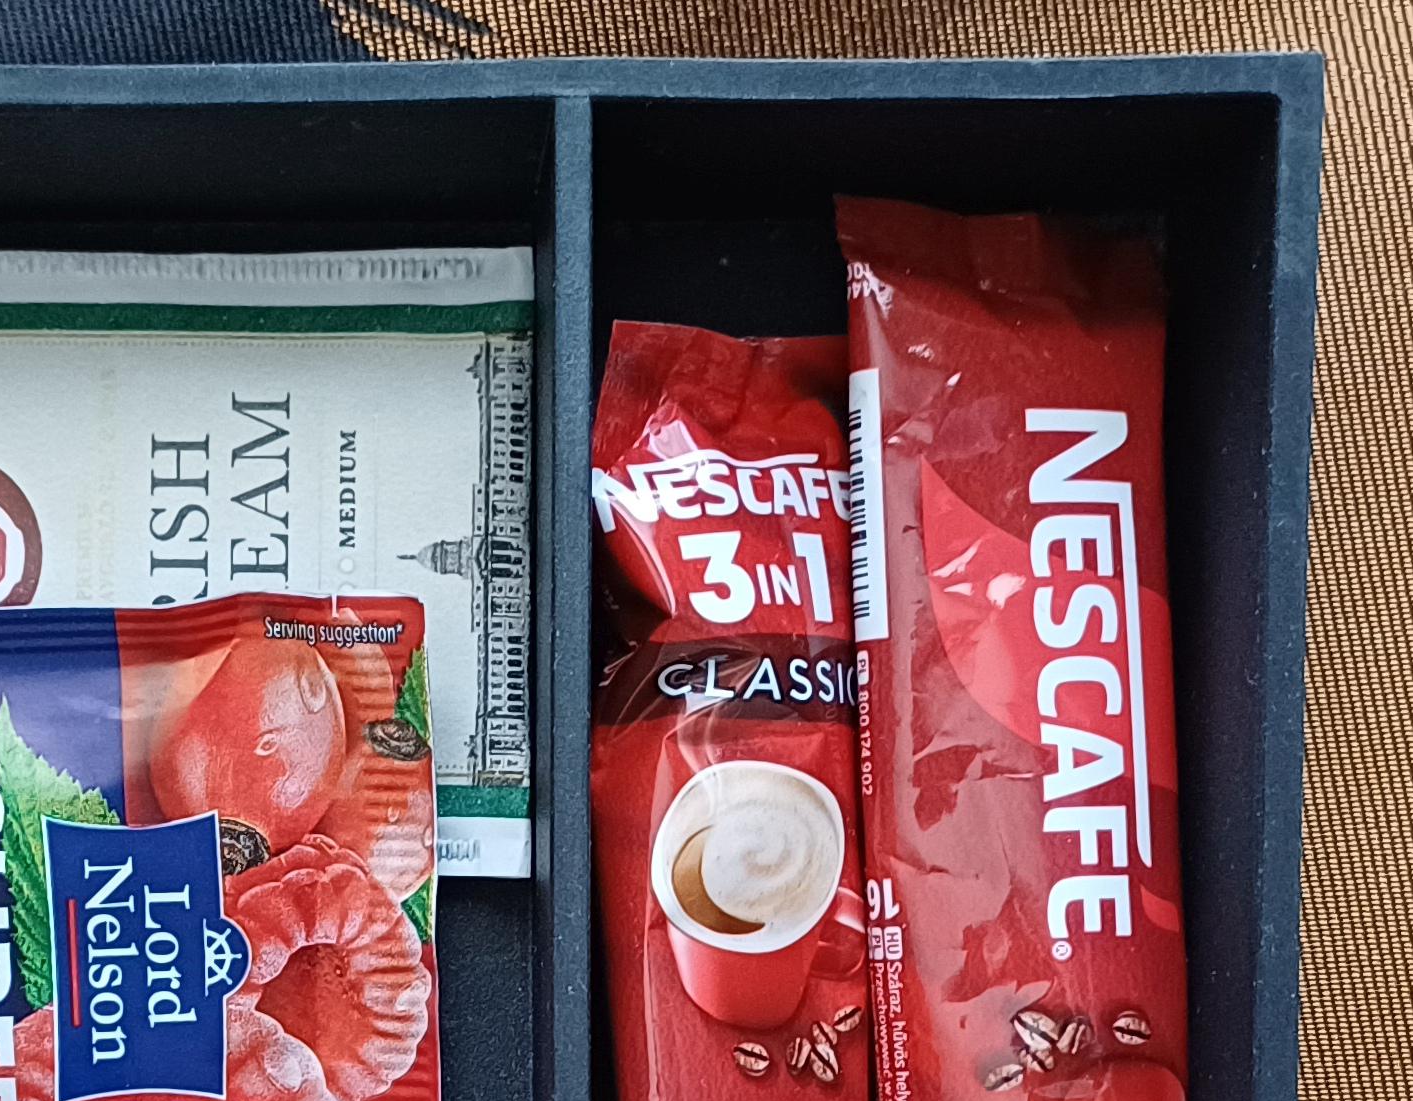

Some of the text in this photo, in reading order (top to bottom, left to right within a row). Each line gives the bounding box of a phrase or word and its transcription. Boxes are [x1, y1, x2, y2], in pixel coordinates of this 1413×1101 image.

[338, 429, 357, 549] MEDIUM
[264, 615, 316, 650] Serving
[858, 689, 870, 727] 800
[859, 729, 872, 759] 174
[860, 760, 874, 797] 902
[83, 855, 140, 1065] Nelson
[143, 883, 198, 1029] Lord
[886, 931, 901, 956] HU
